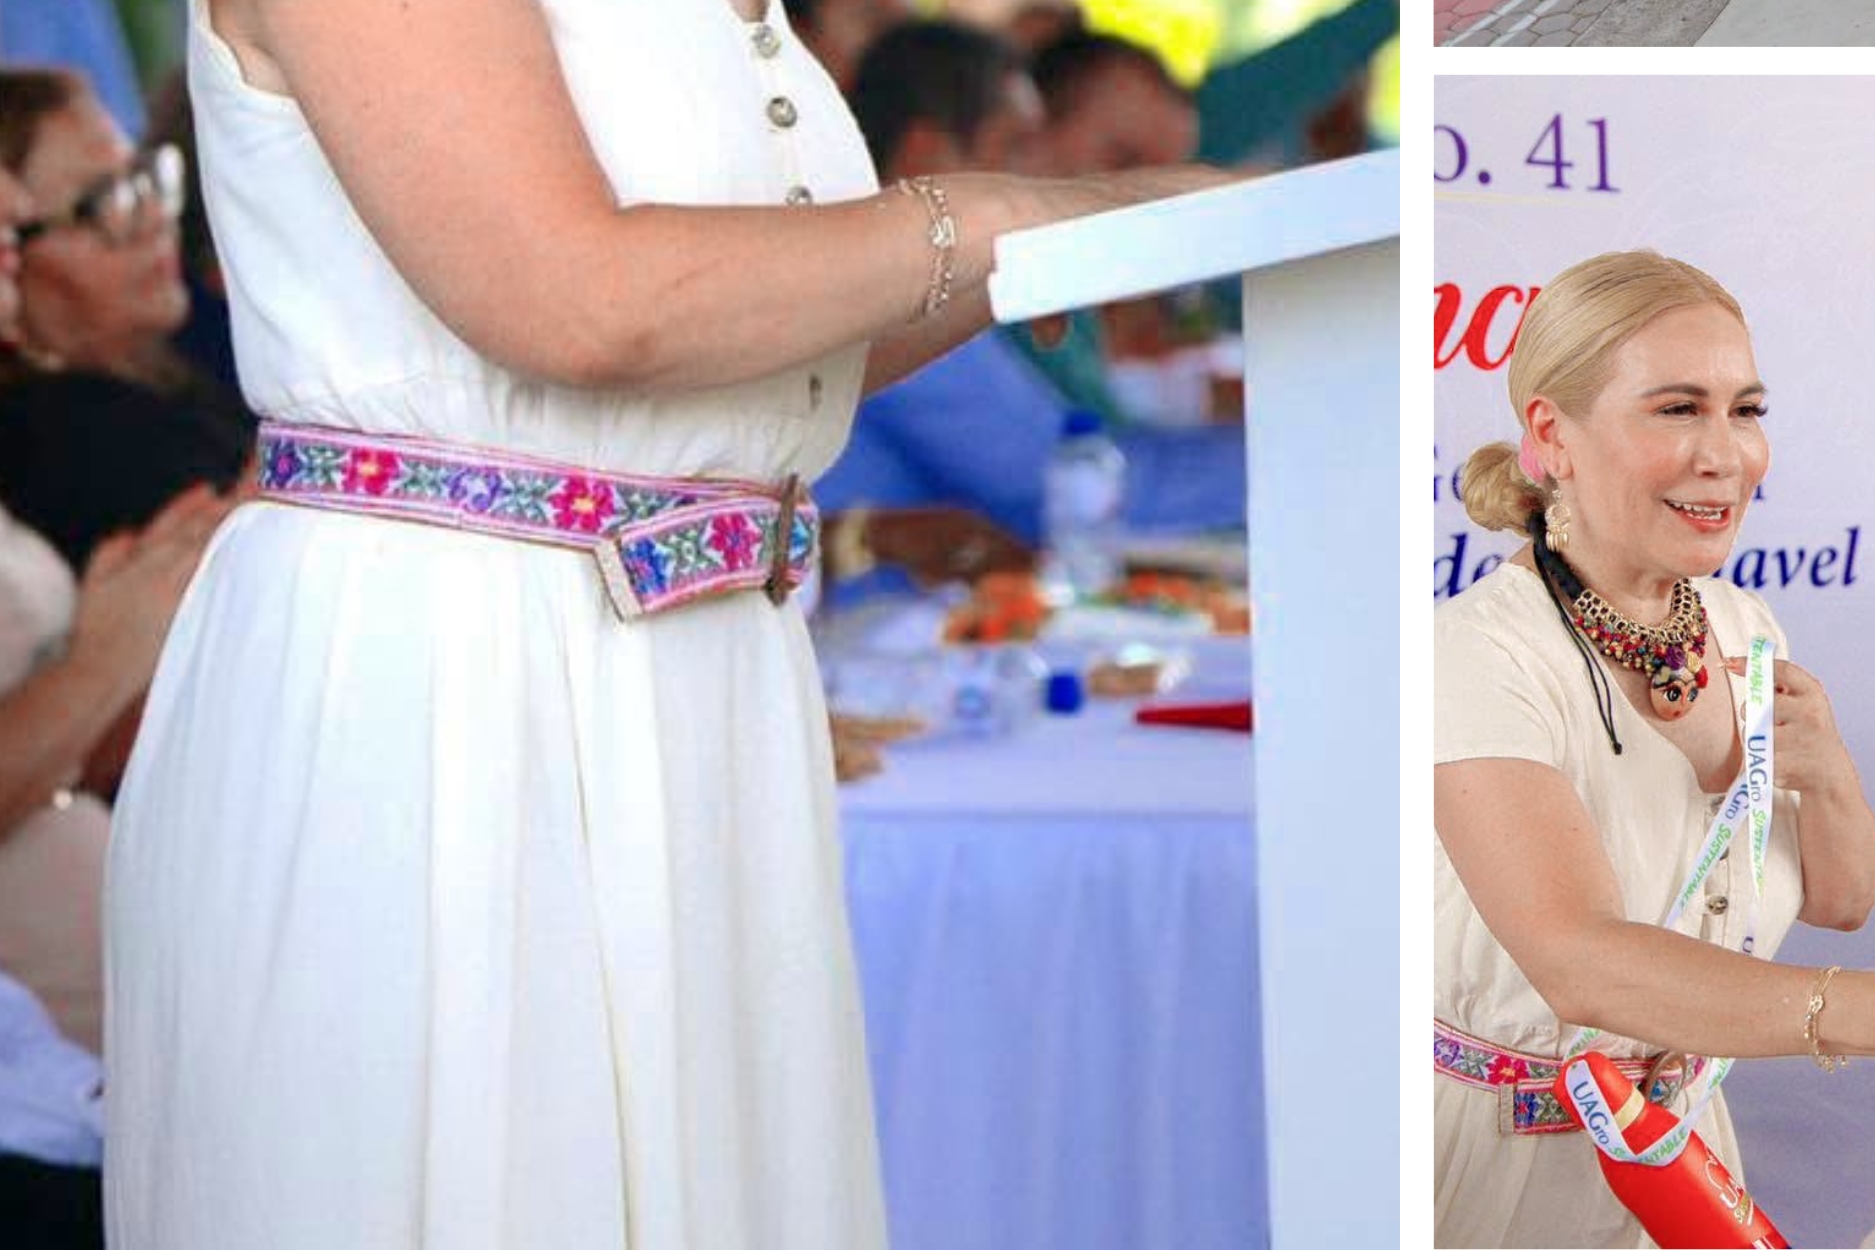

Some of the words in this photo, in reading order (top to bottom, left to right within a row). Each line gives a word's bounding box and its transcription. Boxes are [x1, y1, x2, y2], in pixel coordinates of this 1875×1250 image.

[1434, 124, 1492, 185] o.
[1525, 113, 1622, 192] 41
[1732, 524, 1861, 589] avel
[1747, 734, 1768, 803] UAGro
[1572, 1080, 1611, 1146] UAGro
